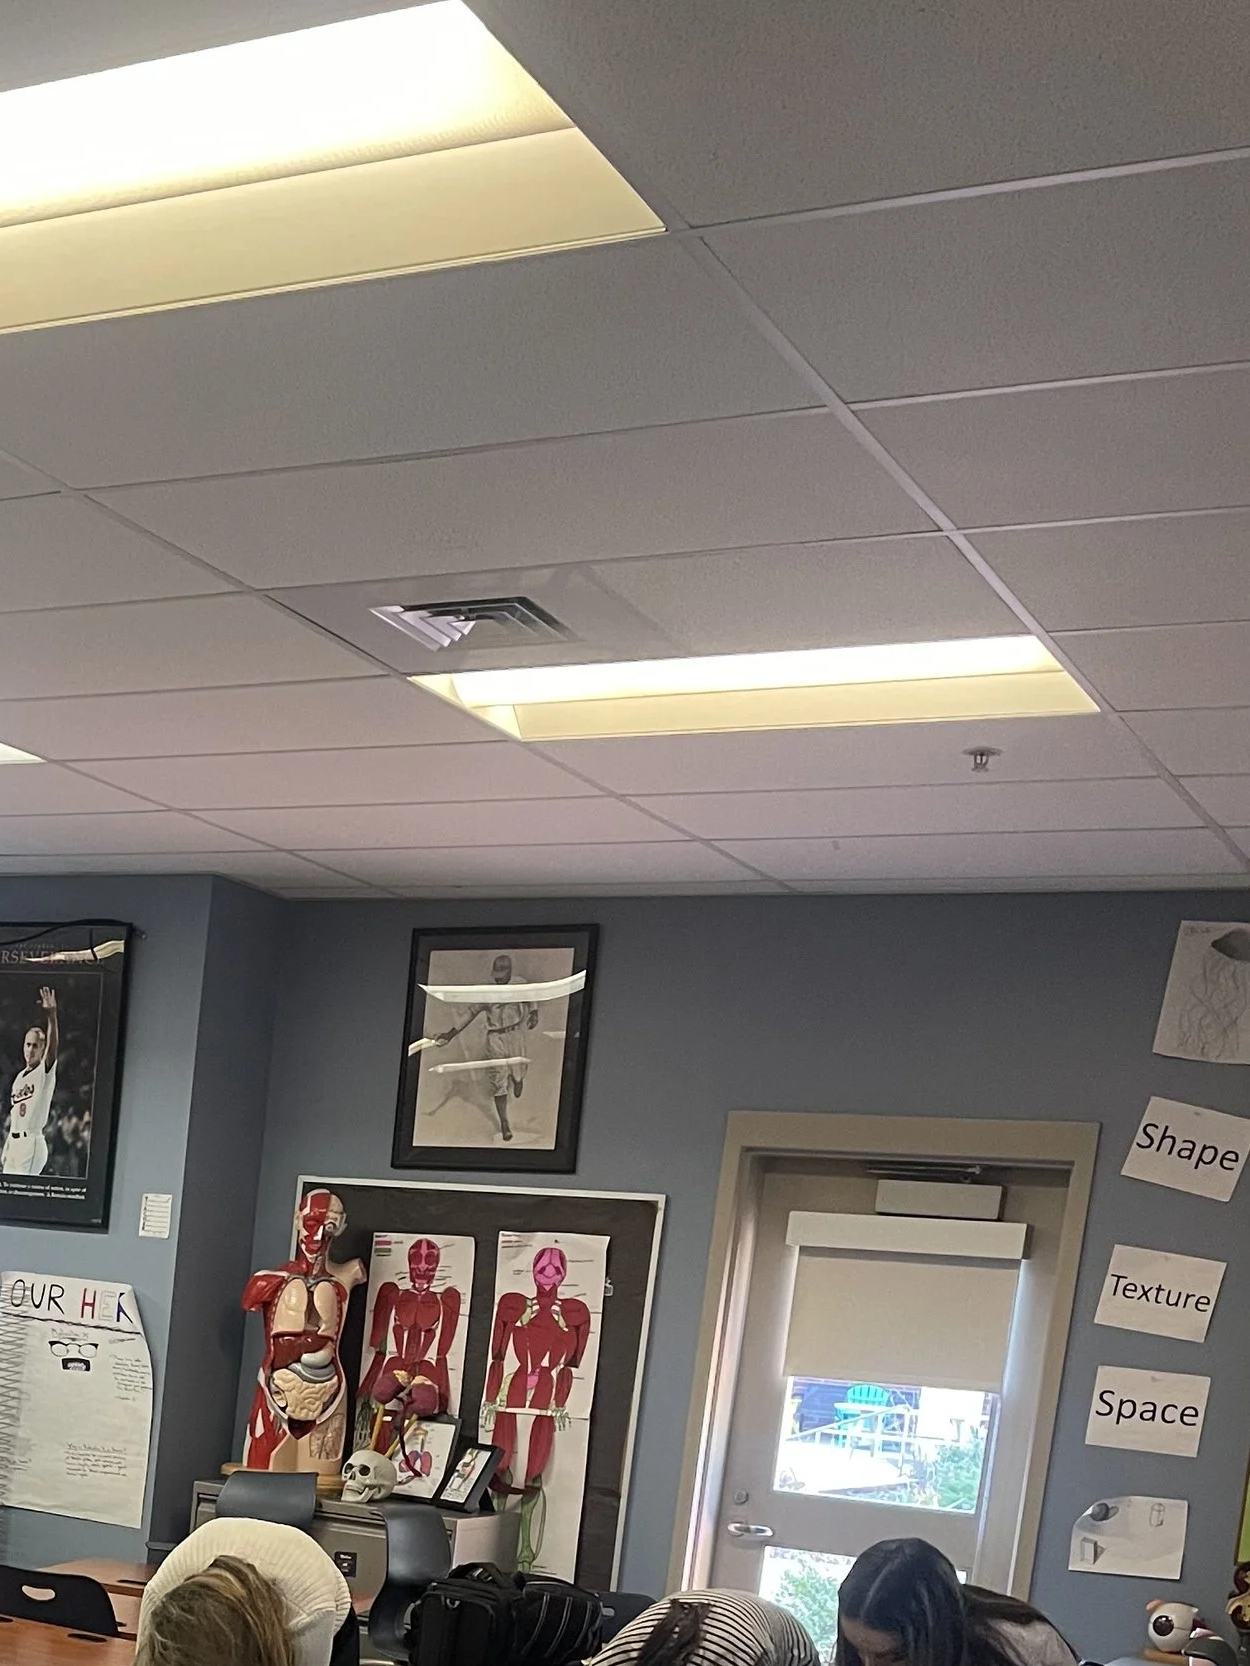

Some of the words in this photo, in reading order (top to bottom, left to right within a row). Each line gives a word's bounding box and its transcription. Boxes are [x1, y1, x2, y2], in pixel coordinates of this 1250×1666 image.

[1135, 1122, 1241, 1172] Shape
[10, 1278, 66, 1316] OUR
[1110, 1273, 1212, 1313] Texture
[1095, 1389, 1200, 1427] Space
